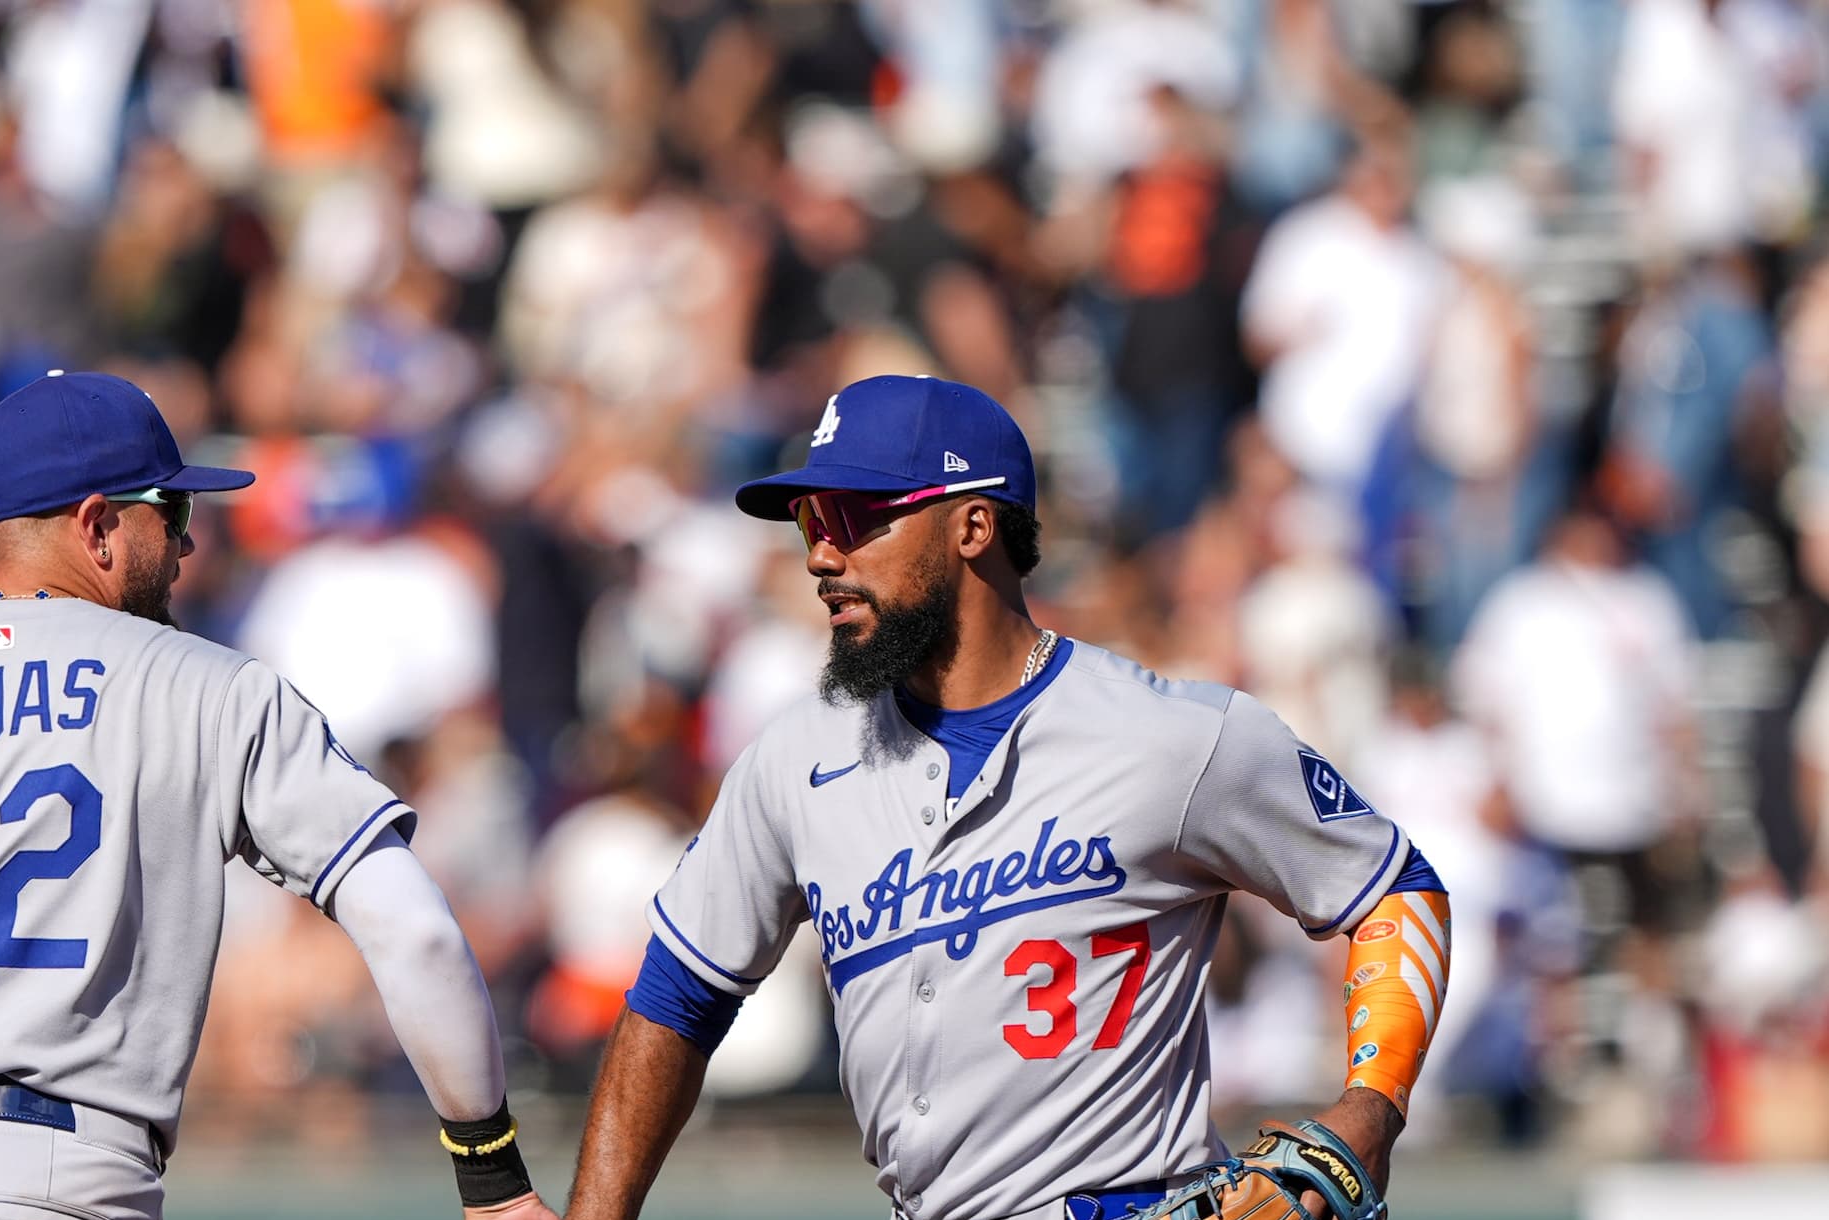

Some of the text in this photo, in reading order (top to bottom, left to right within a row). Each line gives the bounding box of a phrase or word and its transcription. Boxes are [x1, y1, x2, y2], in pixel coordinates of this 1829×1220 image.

[811, 394, 841, 447] LA
[808, 816, 1126, 962] Los Angeles
[1002, 922, 1151, 1060] 37
[1300, 1147, 1361, 1200] Wilson
